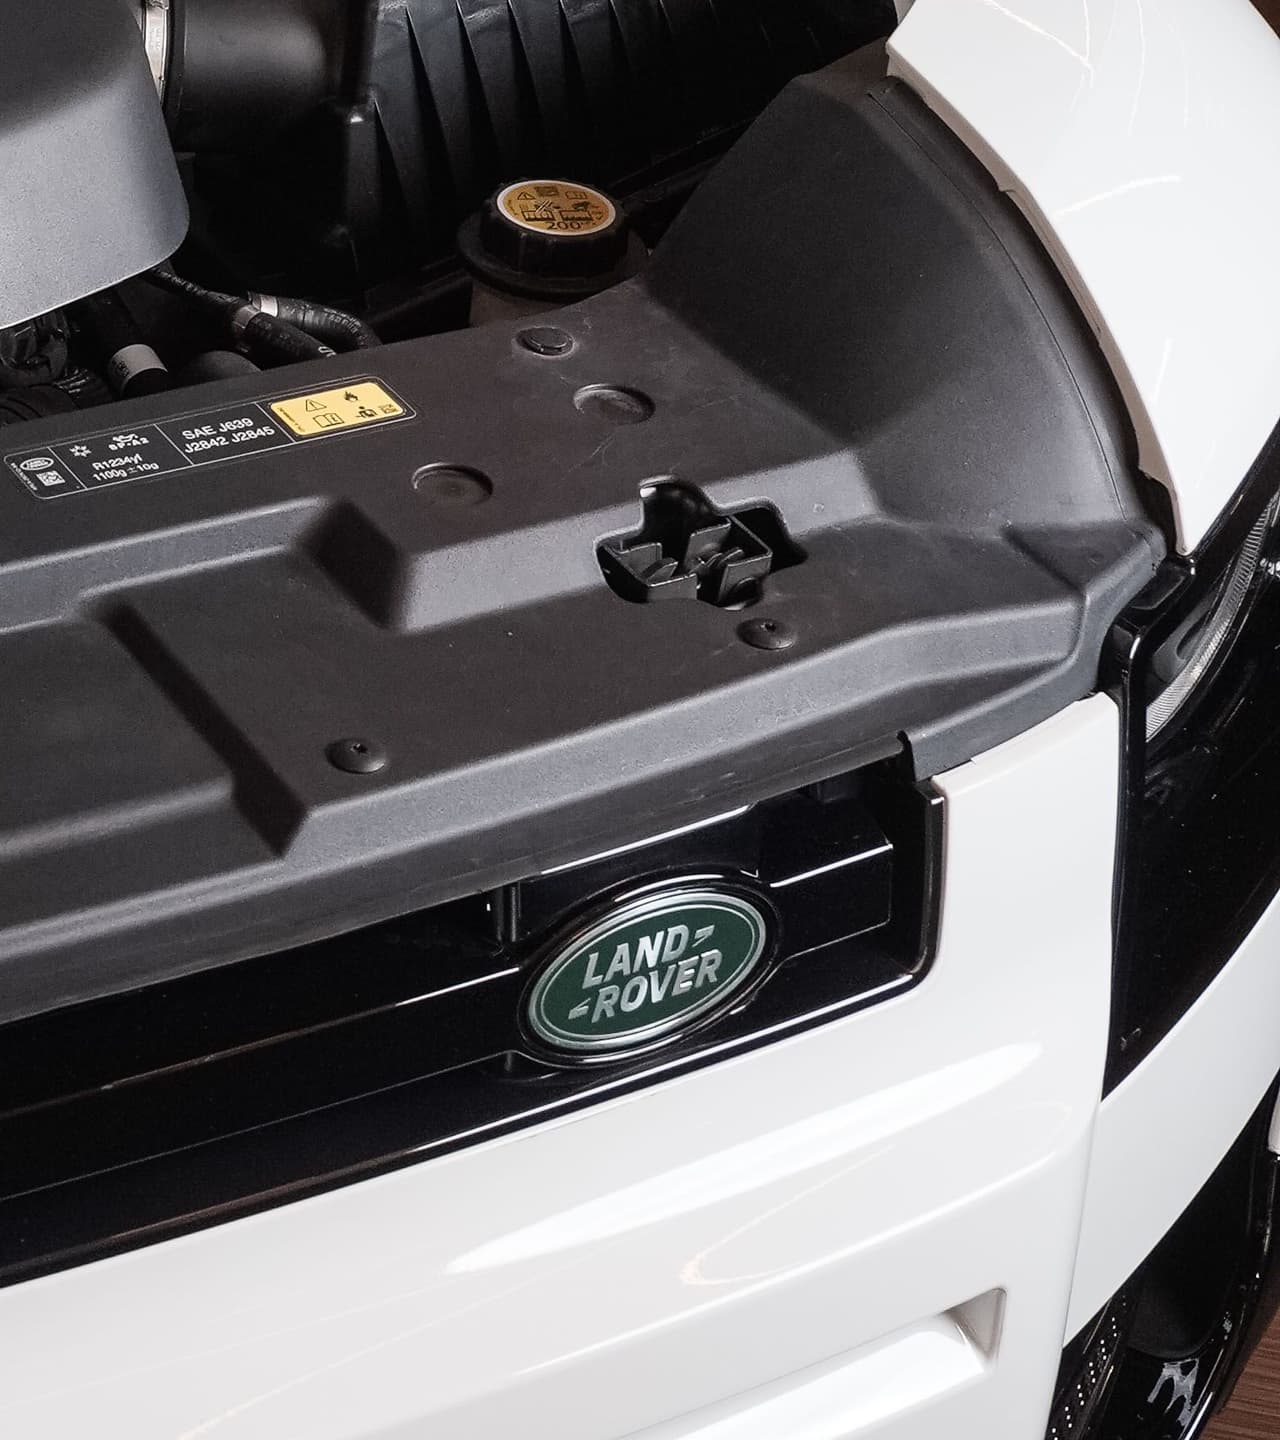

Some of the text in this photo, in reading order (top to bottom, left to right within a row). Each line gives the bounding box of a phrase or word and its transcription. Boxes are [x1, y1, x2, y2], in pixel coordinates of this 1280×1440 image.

[547, 220, 581, 231] 200
[182, 417, 254, 440] SAE J639
[184, 425, 276, 454] J2842 J2845
[91, 453, 144, 471] R1234yf
[92, 468, 128, 482] 1100g
[582, 923, 690, 990] LAND
[590, 948, 724, 1024] ROVER
